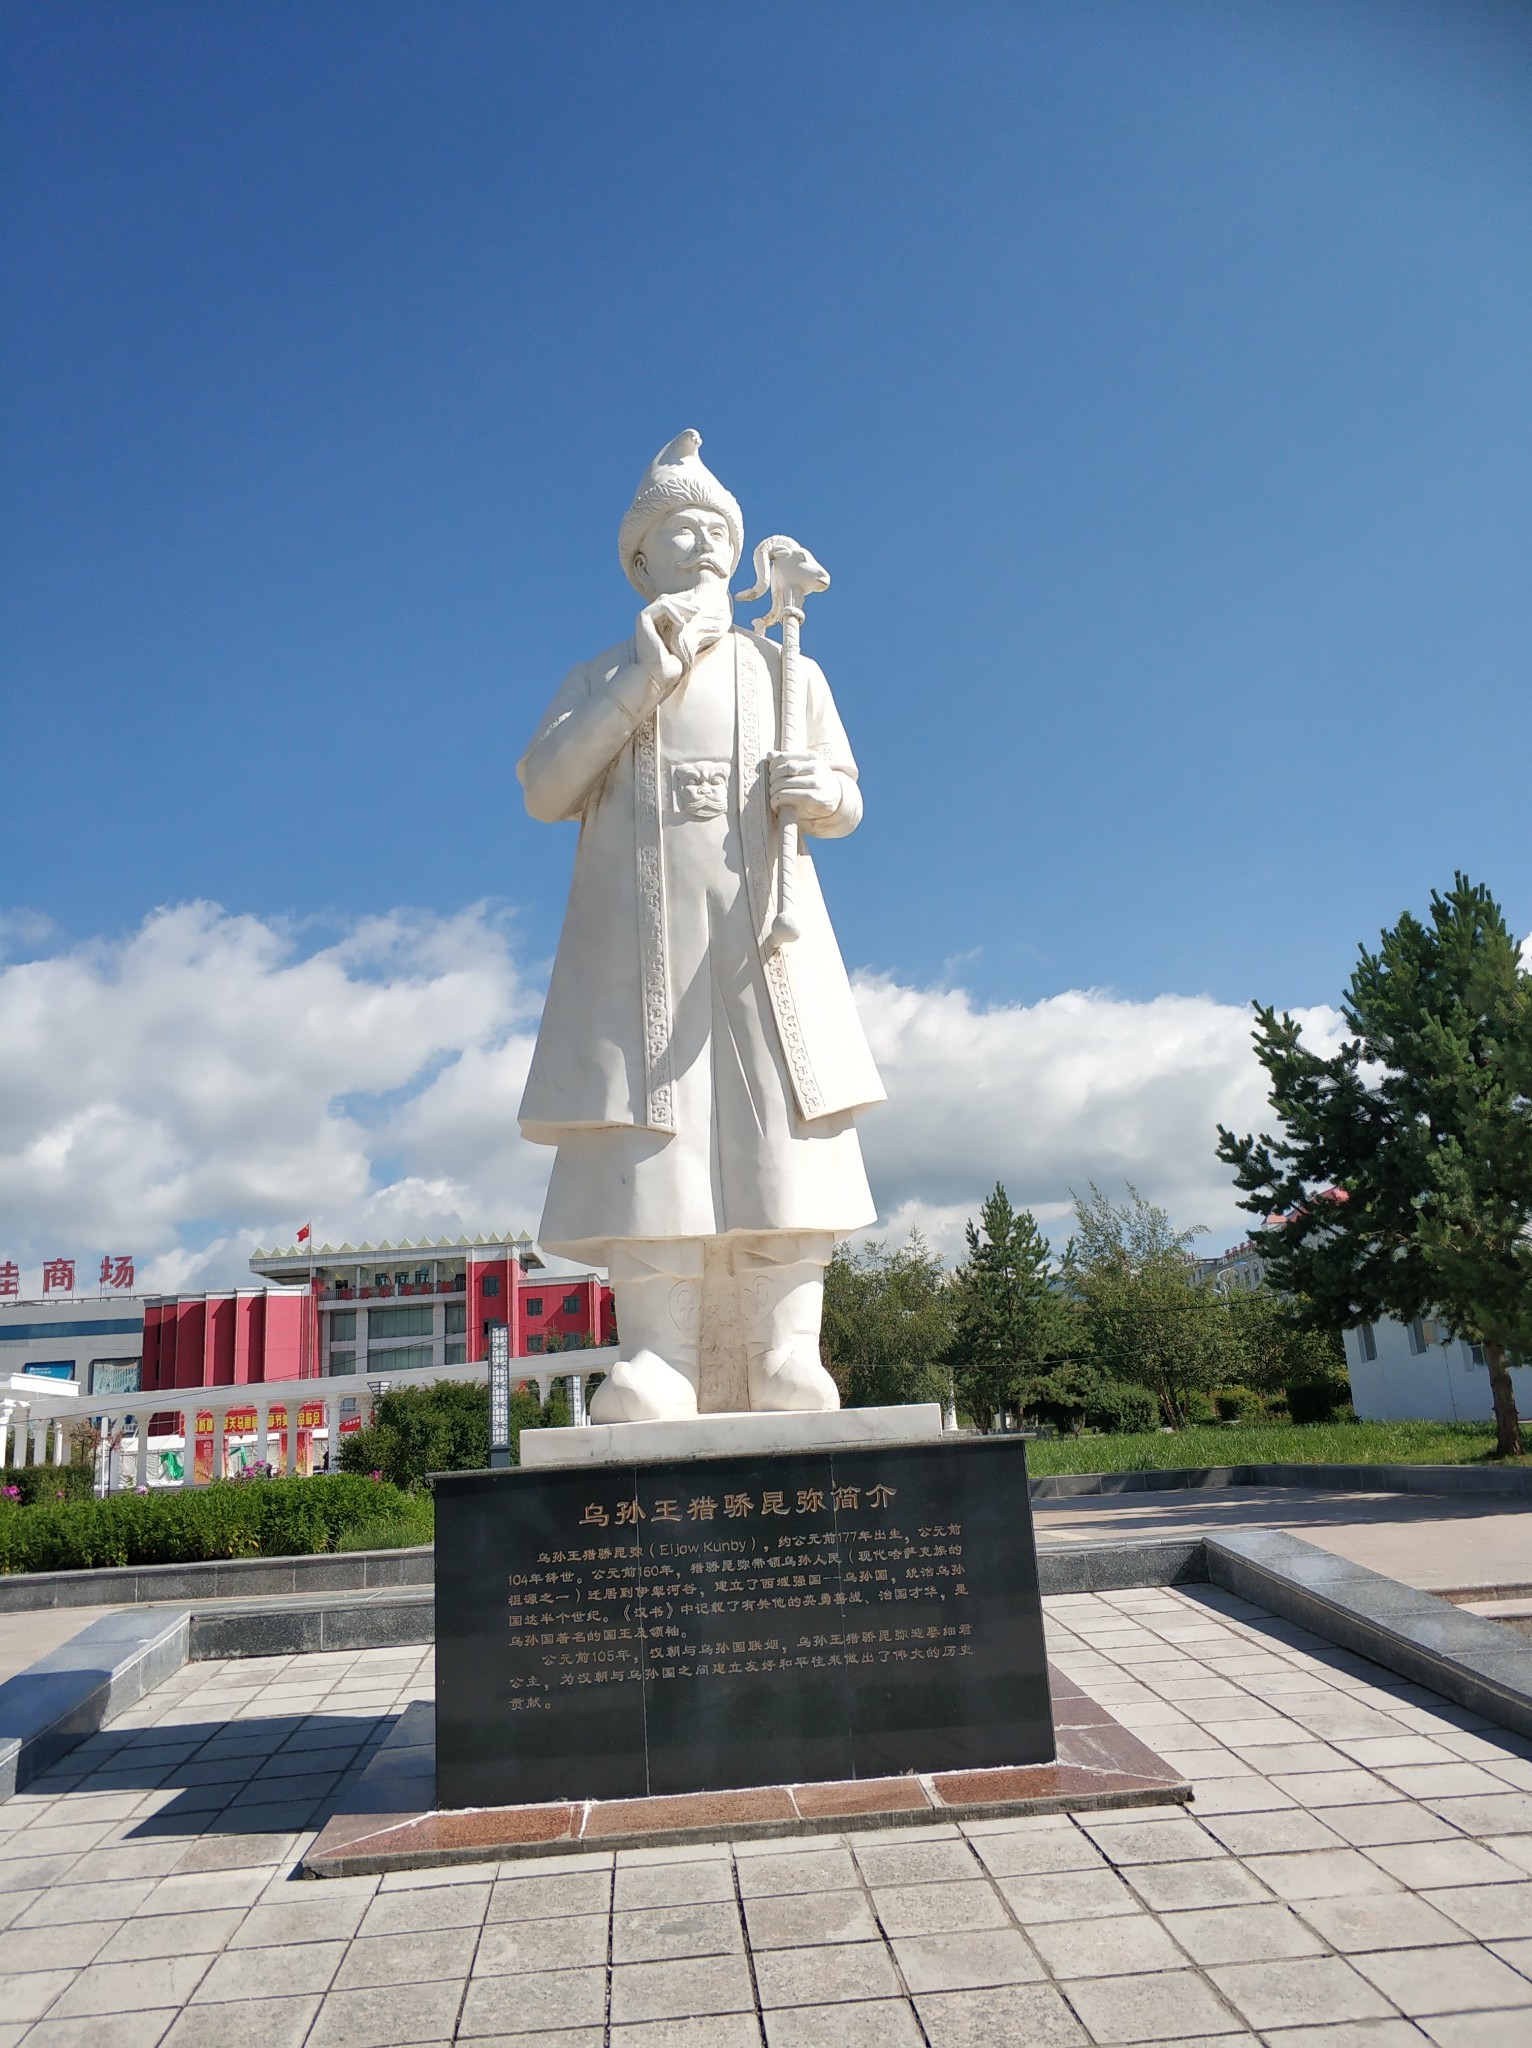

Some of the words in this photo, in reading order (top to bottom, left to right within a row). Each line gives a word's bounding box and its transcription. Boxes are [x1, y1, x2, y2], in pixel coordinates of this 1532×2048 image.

[578, 1483, 897, 1527] 乌孙王猎骄昆弥简介
[508, 1624, 688, 1648] 乌孙国著名的国王及领袖。
[508, 1696, 552, 1711] 贡献。
